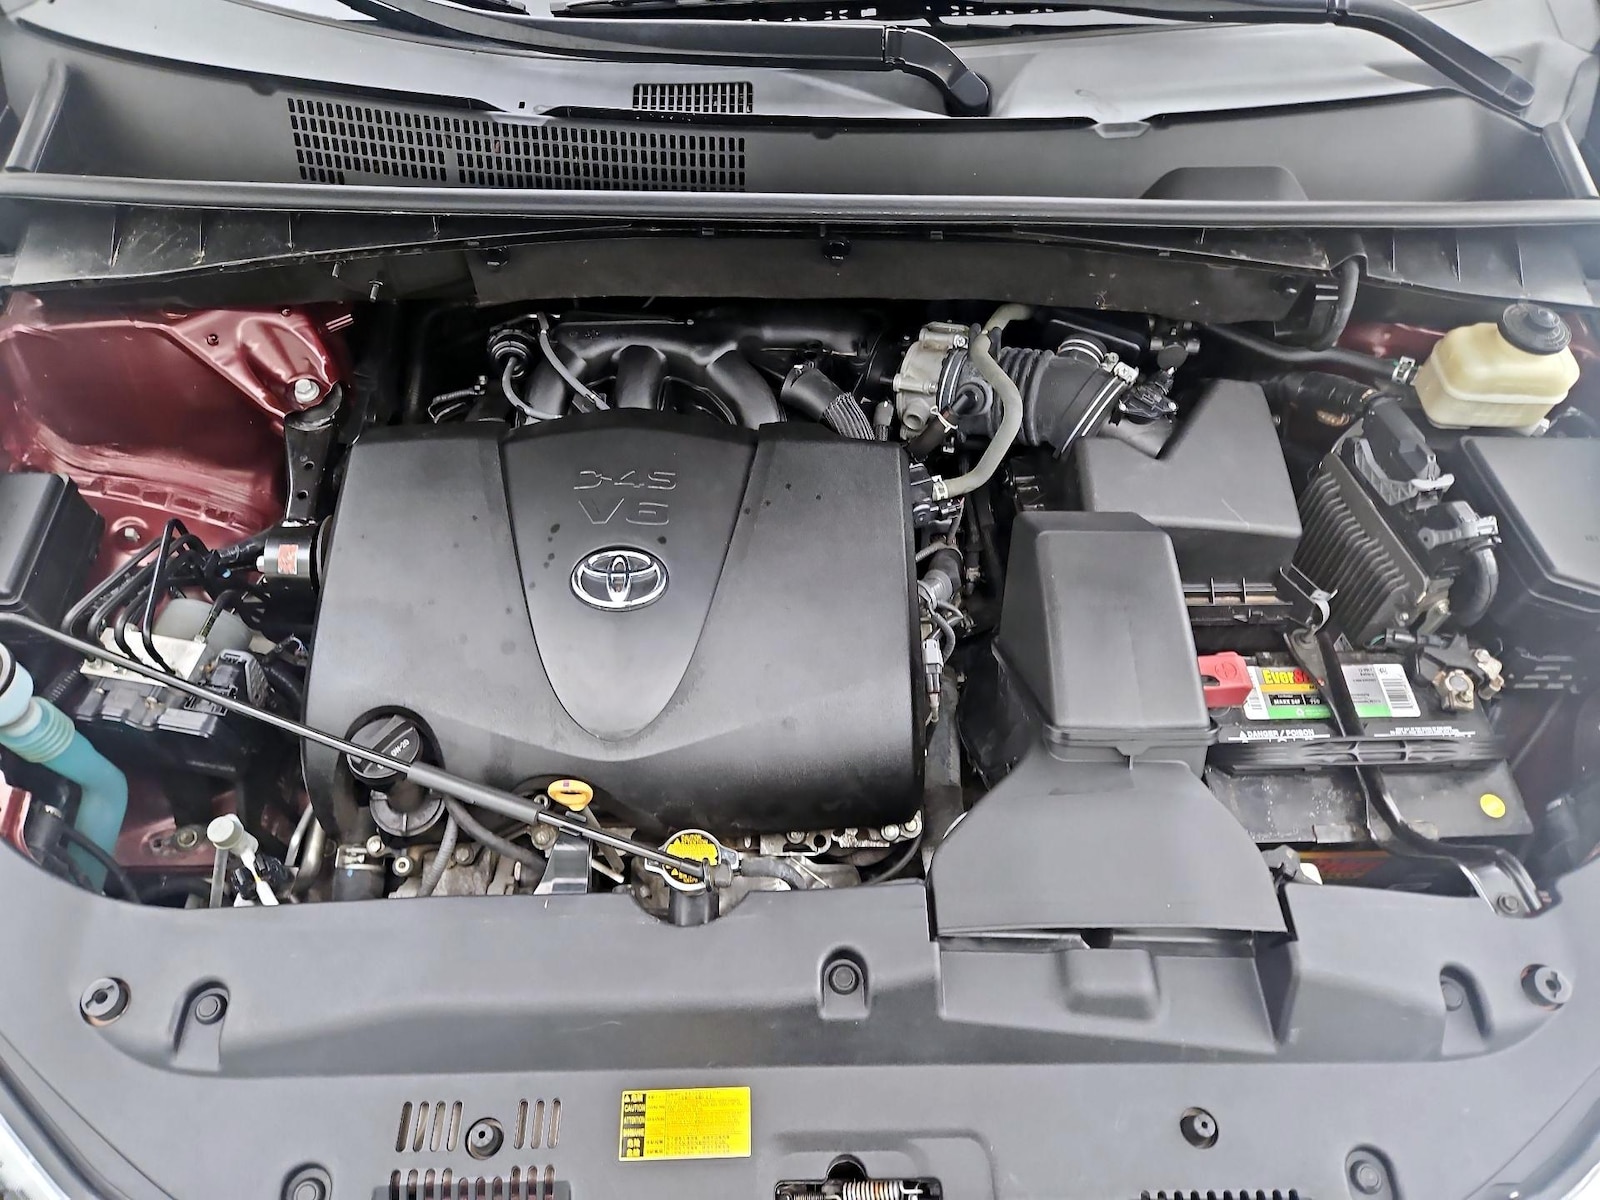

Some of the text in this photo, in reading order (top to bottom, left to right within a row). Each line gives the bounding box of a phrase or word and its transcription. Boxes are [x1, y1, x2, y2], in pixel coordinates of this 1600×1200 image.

[577, 497, 670, 526] V6
[1246, 729, 1279, 739] DANGER
[1285, 728, 1315, 738] POISON
